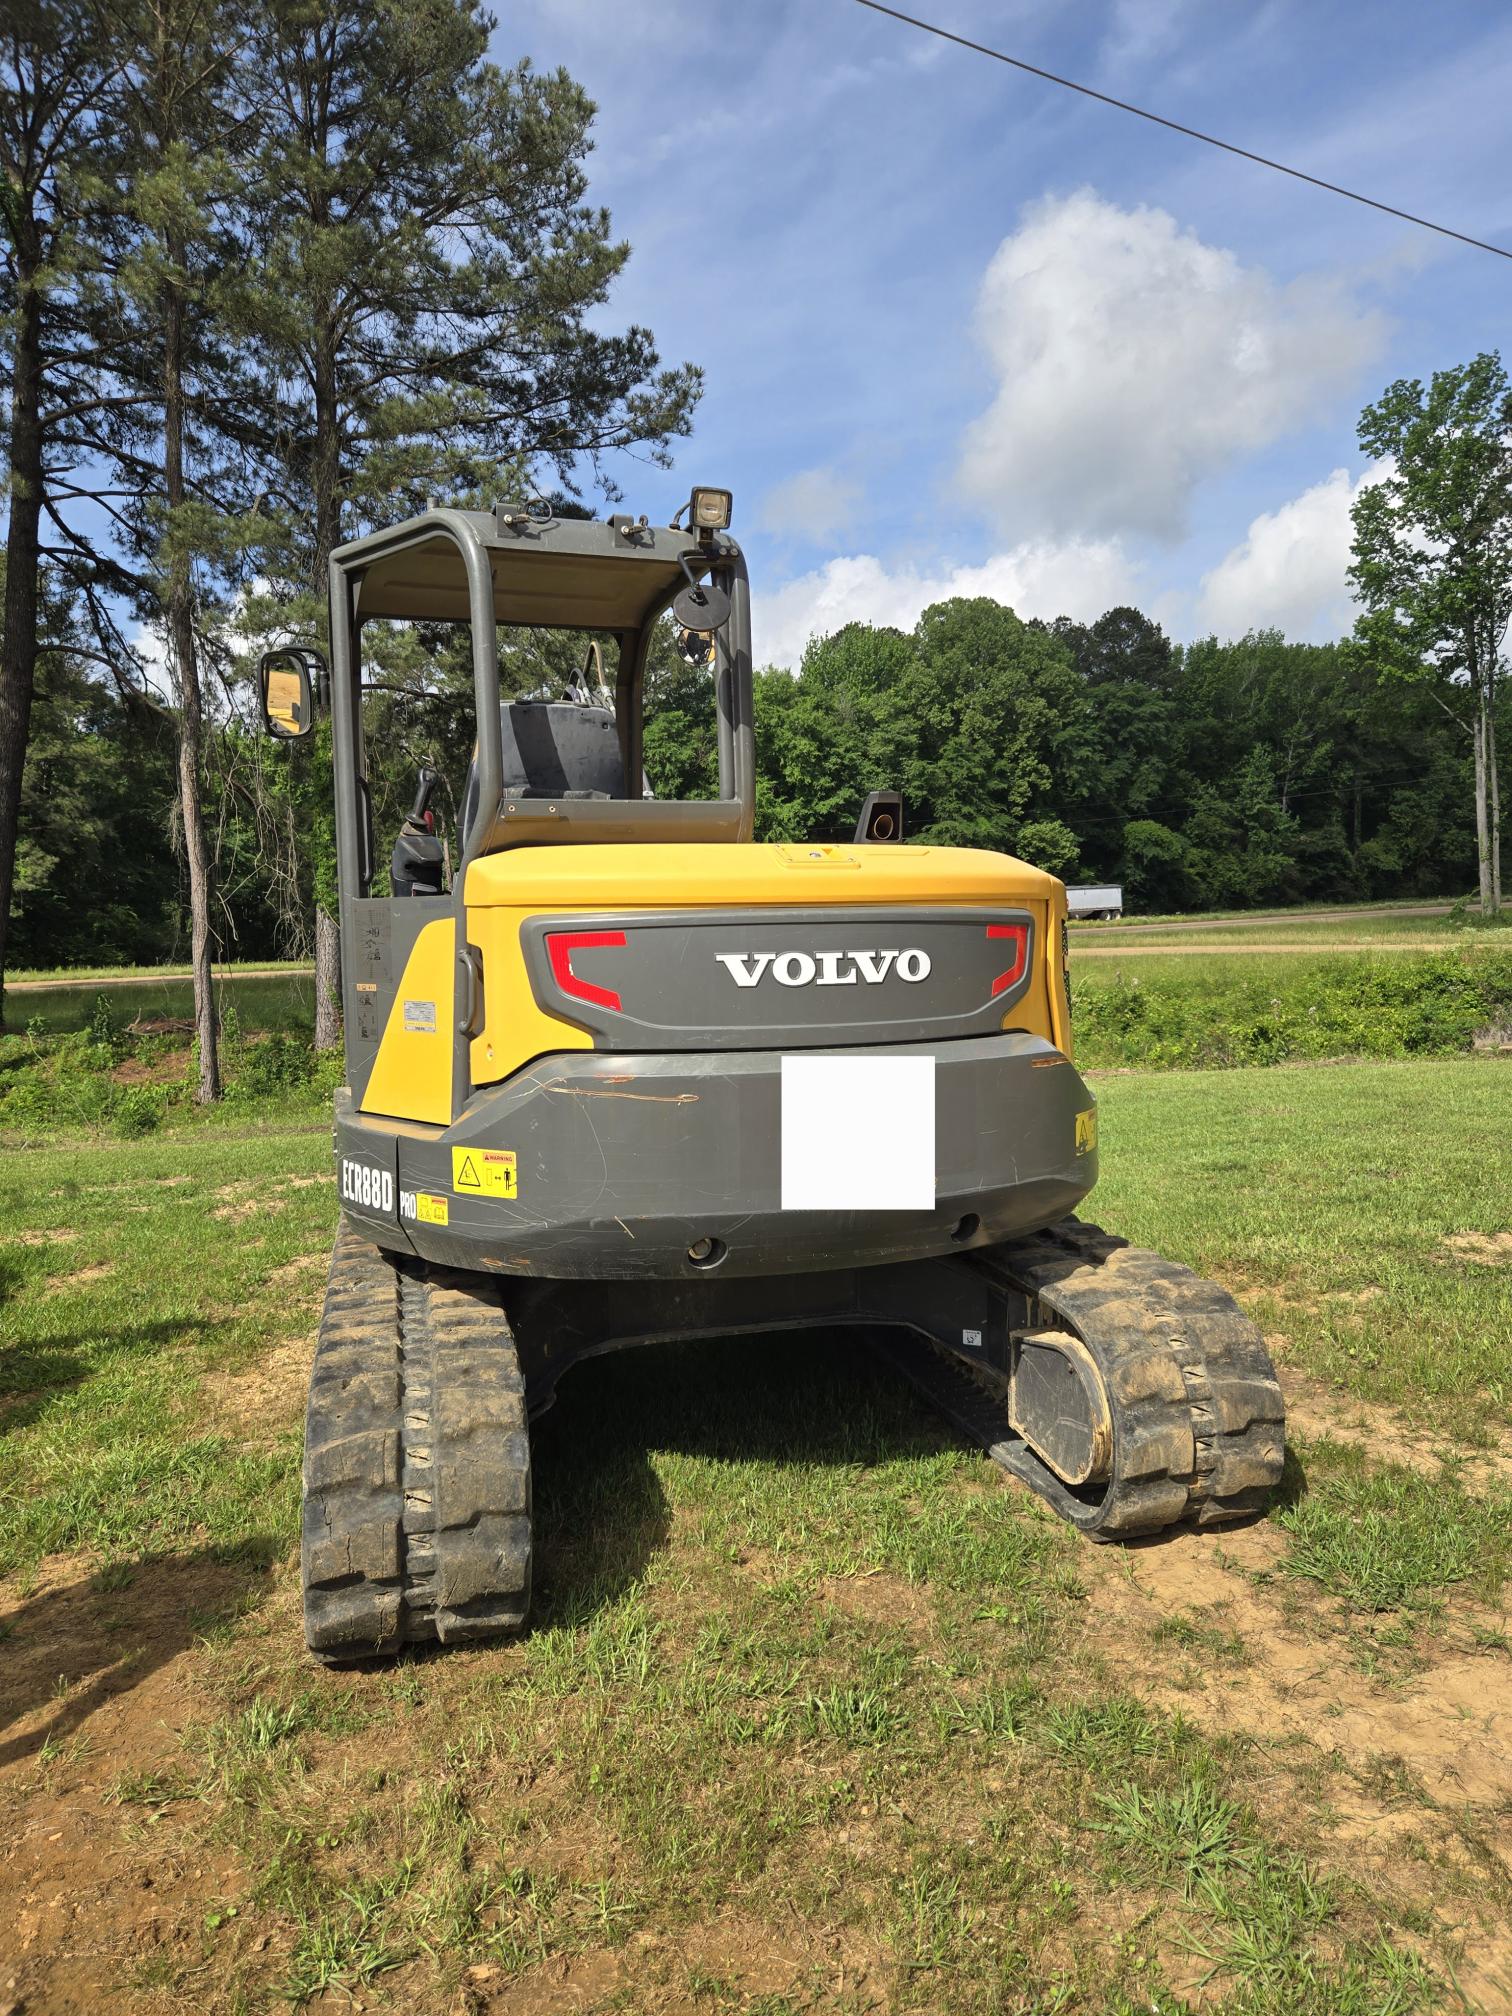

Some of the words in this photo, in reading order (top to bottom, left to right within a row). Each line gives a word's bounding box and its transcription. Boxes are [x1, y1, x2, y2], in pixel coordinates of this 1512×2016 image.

[715, 949, 932, 988] VOLVO
[342, 1159, 393, 1212] ECR88D
[399, 1190, 417, 1220] PRO
